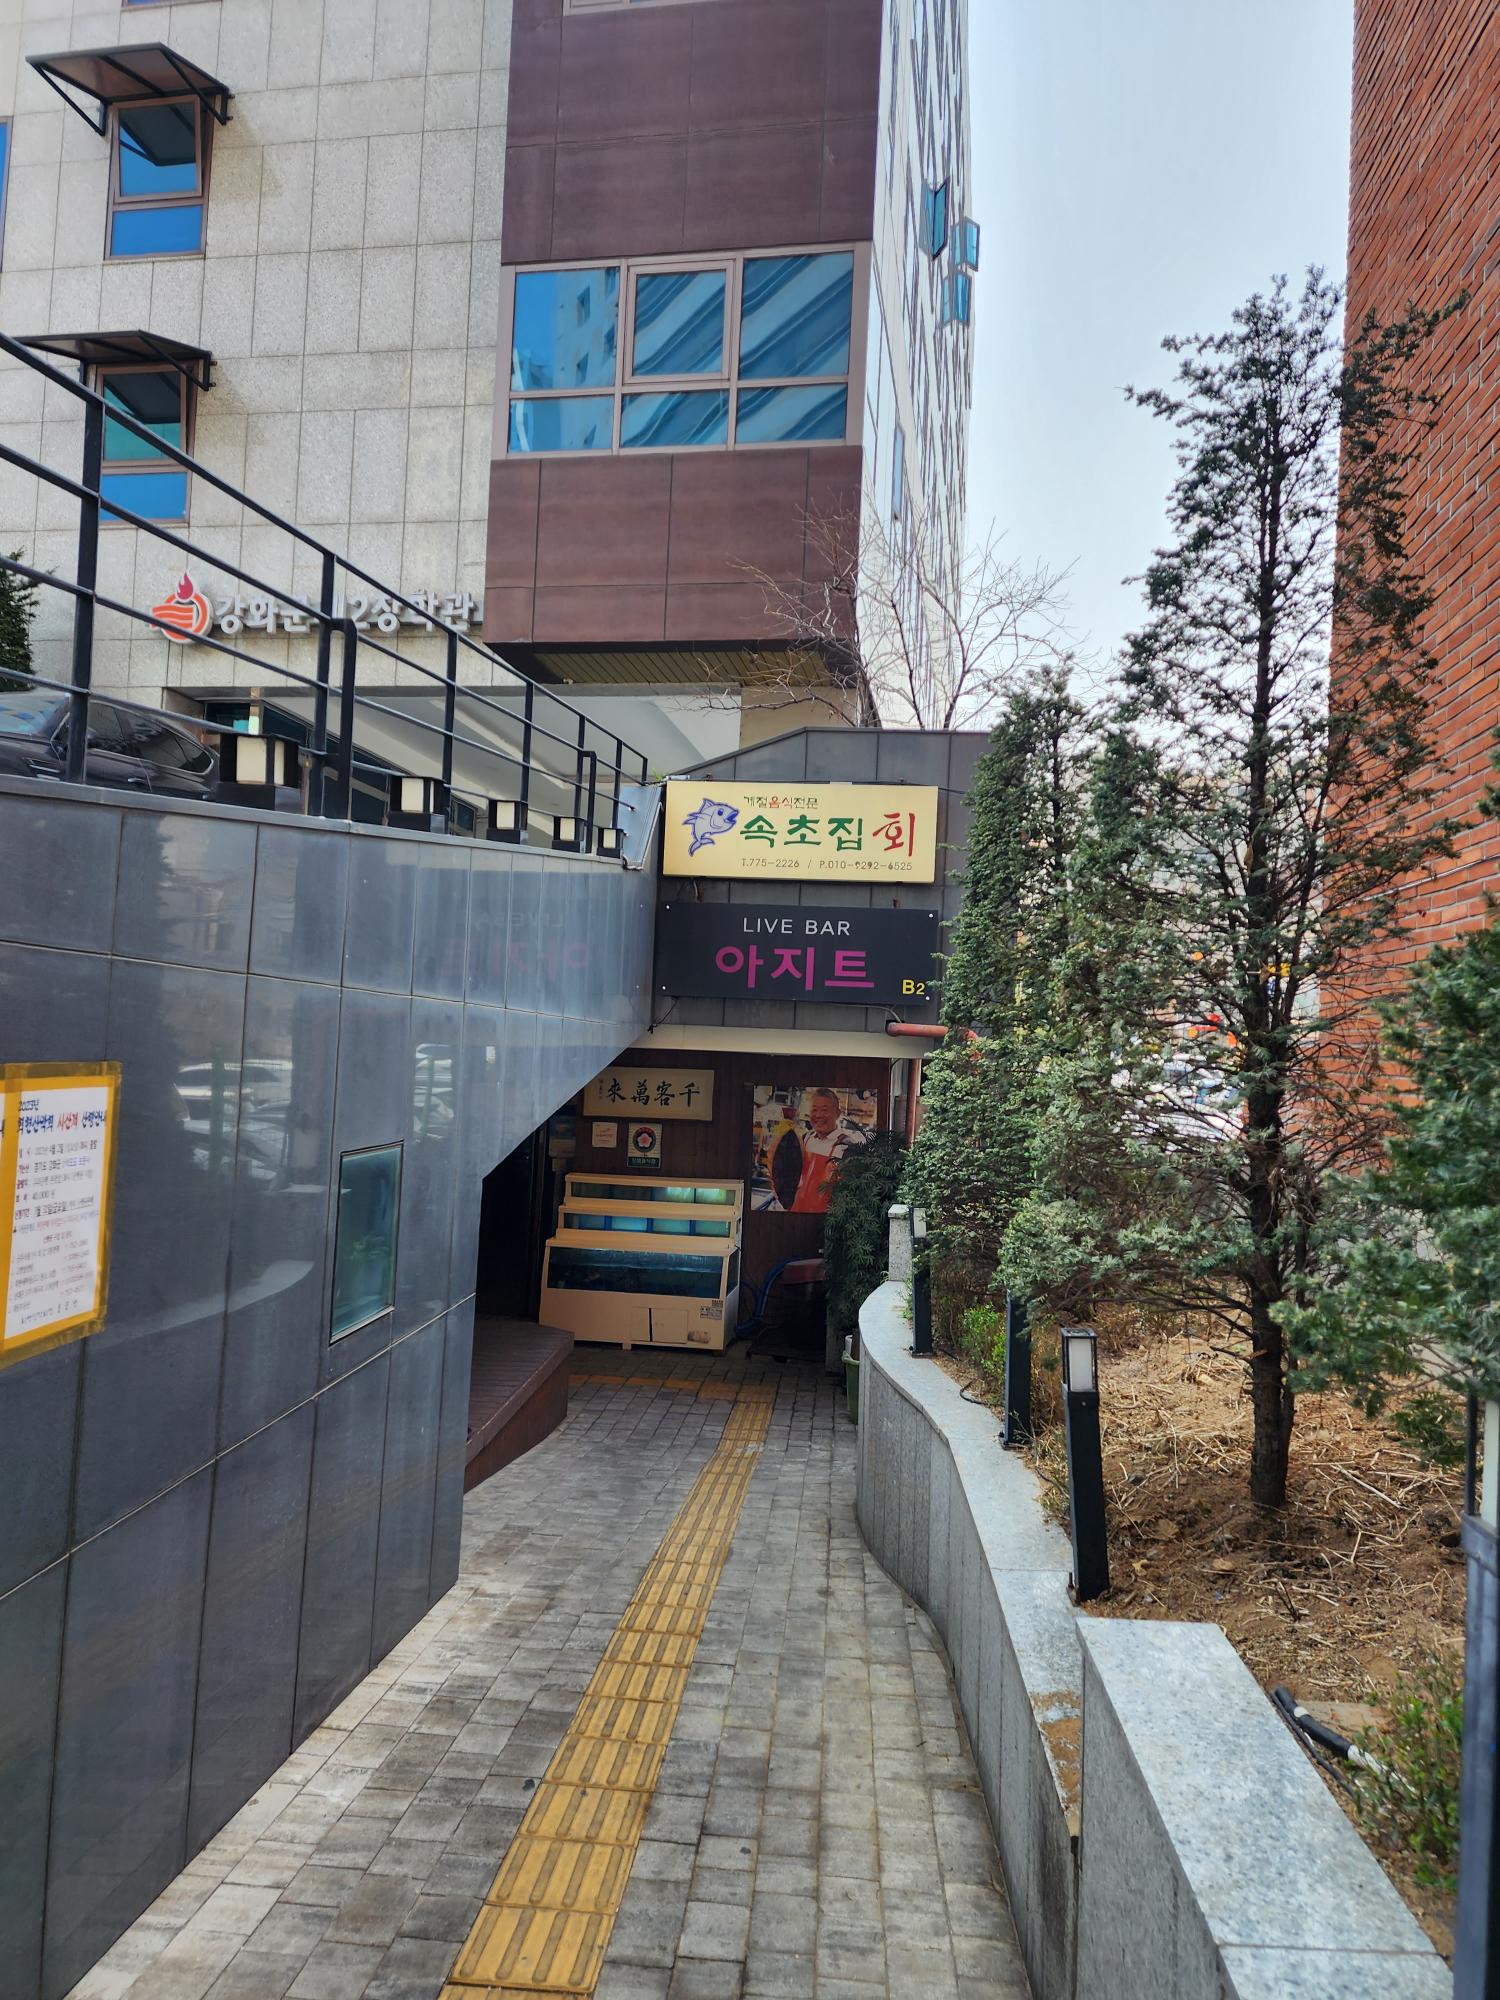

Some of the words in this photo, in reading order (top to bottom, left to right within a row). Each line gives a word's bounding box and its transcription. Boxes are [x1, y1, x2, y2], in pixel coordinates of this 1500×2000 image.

[740, 814, 863, 851] 속초집
[872, 812, 916, 857] 회
[741, 858, 800, 868] T.775-2226
[743, 917, 793, 934] LIVE
[805, 919, 850, 936] BAR
[715, 944, 875, 991] 아지트
[902, 979, 925, 995] B2
